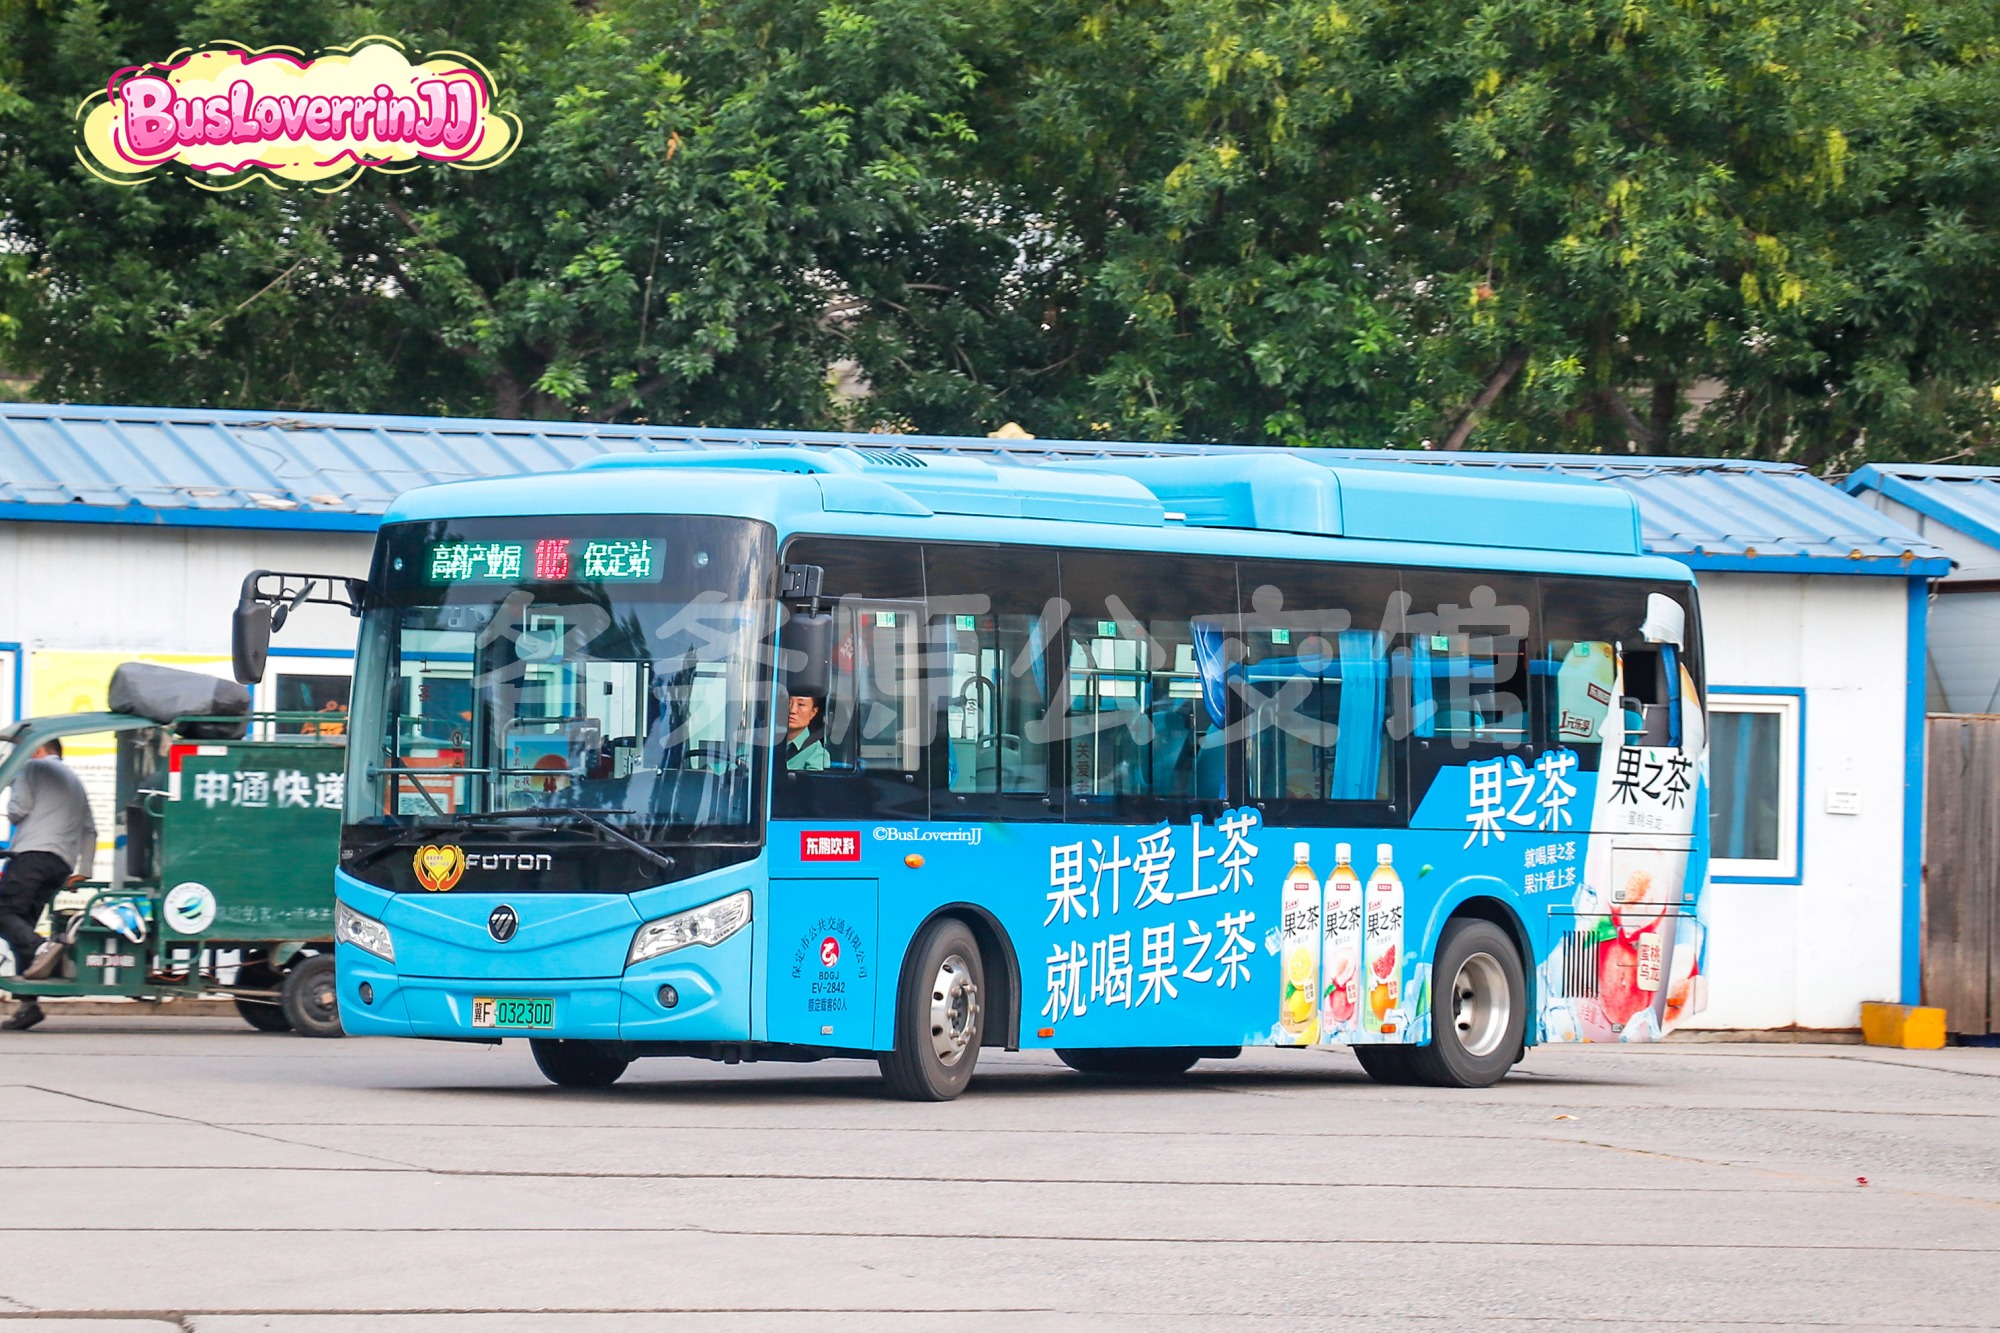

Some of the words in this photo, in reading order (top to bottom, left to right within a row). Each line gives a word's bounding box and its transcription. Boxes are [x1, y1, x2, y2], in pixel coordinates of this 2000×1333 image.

[583, 540, 653, 578] 保定站
[194, 769, 344, 810] 申通快递
[1608, 748, 1693, 811] 果之茶
[1463, 753, 1577, 850] 果之茶
[465, 854, 552, 870] FOTON
[806, 837, 855, 855] 东鹏饮料
[1524, 841, 1576, 868] 就喝果之茶
[1043, 814, 1259, 927] 果汁爱上茶
[1524, 867, 1576, 894] 果汁爱上茶
[1282, 905, 1319, 940] 果之茶
[1324, 905, 1361, 940] 果之茶
[1366, 906, 1402, 940] 果之茶
[792, 917, 867, 979] 保定市公共交通有限公司
[818, 971, 840, 980] BDGJ
[1041, 910, 1256, 1024] 就喝果之茶
[812, 982, 846, 994] EV-2842
